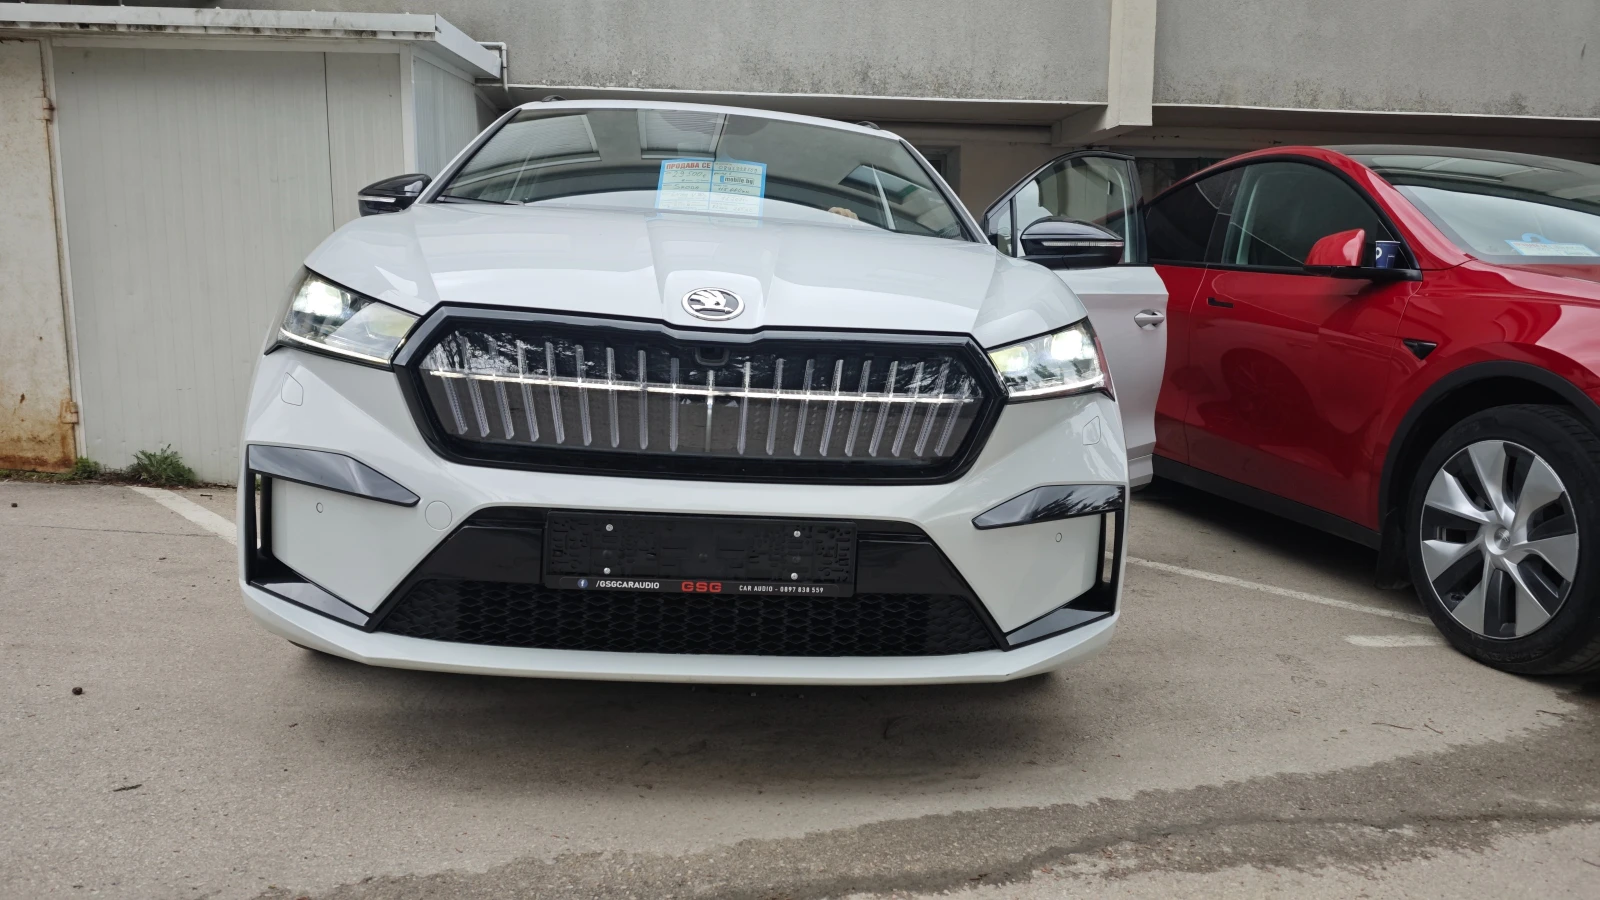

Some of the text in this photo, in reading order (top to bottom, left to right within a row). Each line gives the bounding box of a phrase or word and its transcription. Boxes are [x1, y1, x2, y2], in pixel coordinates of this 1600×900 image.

[666, 162, 699, 171] ПРОДАВА
[595, 580, 660, 589] /GSGCARAUDIO
[681, 581, 722, 593] GSG
